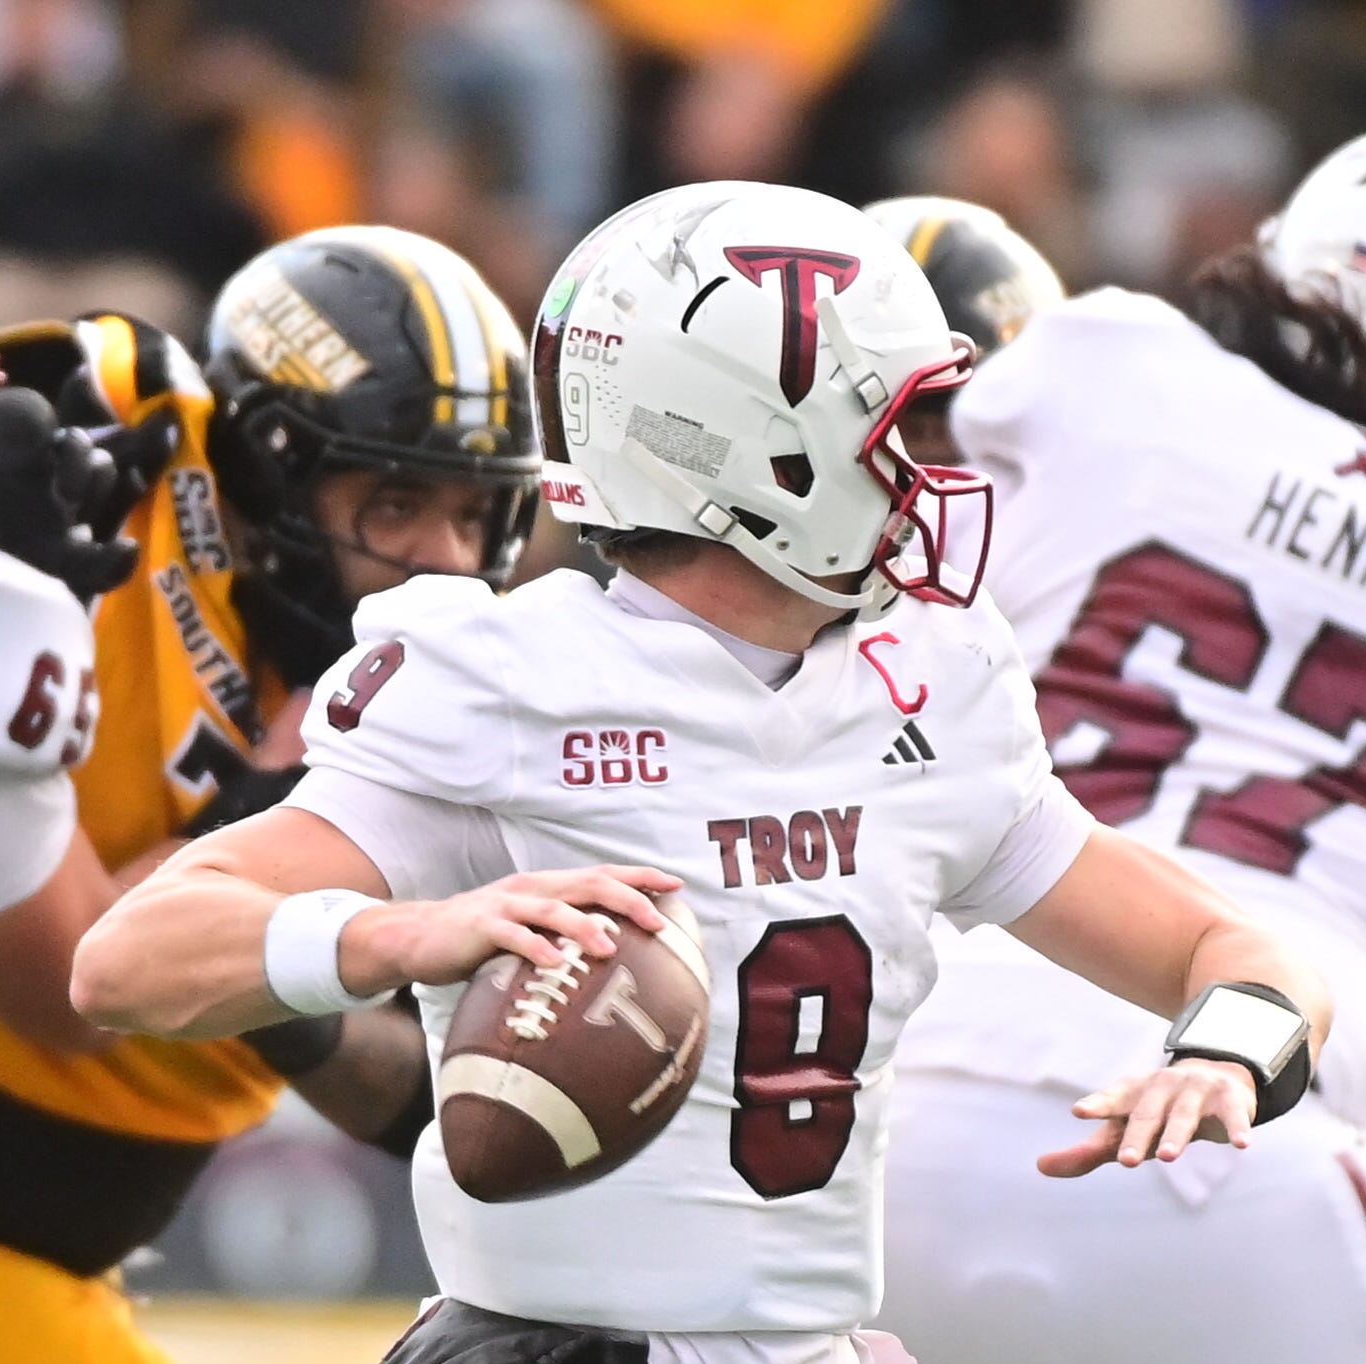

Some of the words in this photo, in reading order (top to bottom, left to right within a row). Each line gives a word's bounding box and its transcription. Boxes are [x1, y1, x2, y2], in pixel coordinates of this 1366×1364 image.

[566, 326, 623, 366] SBC
[724, 246, 861, 408] T
[564, 371, 589, 446] 9
[7, 650, 98, 766] 65
[326, 640, 406, 733] 9
[858, 631, 929, 715] C
[562, 729, 669, 786] SBC
[707, 804, 863, 890] TROY
[582, 963, 667, 1053] T
